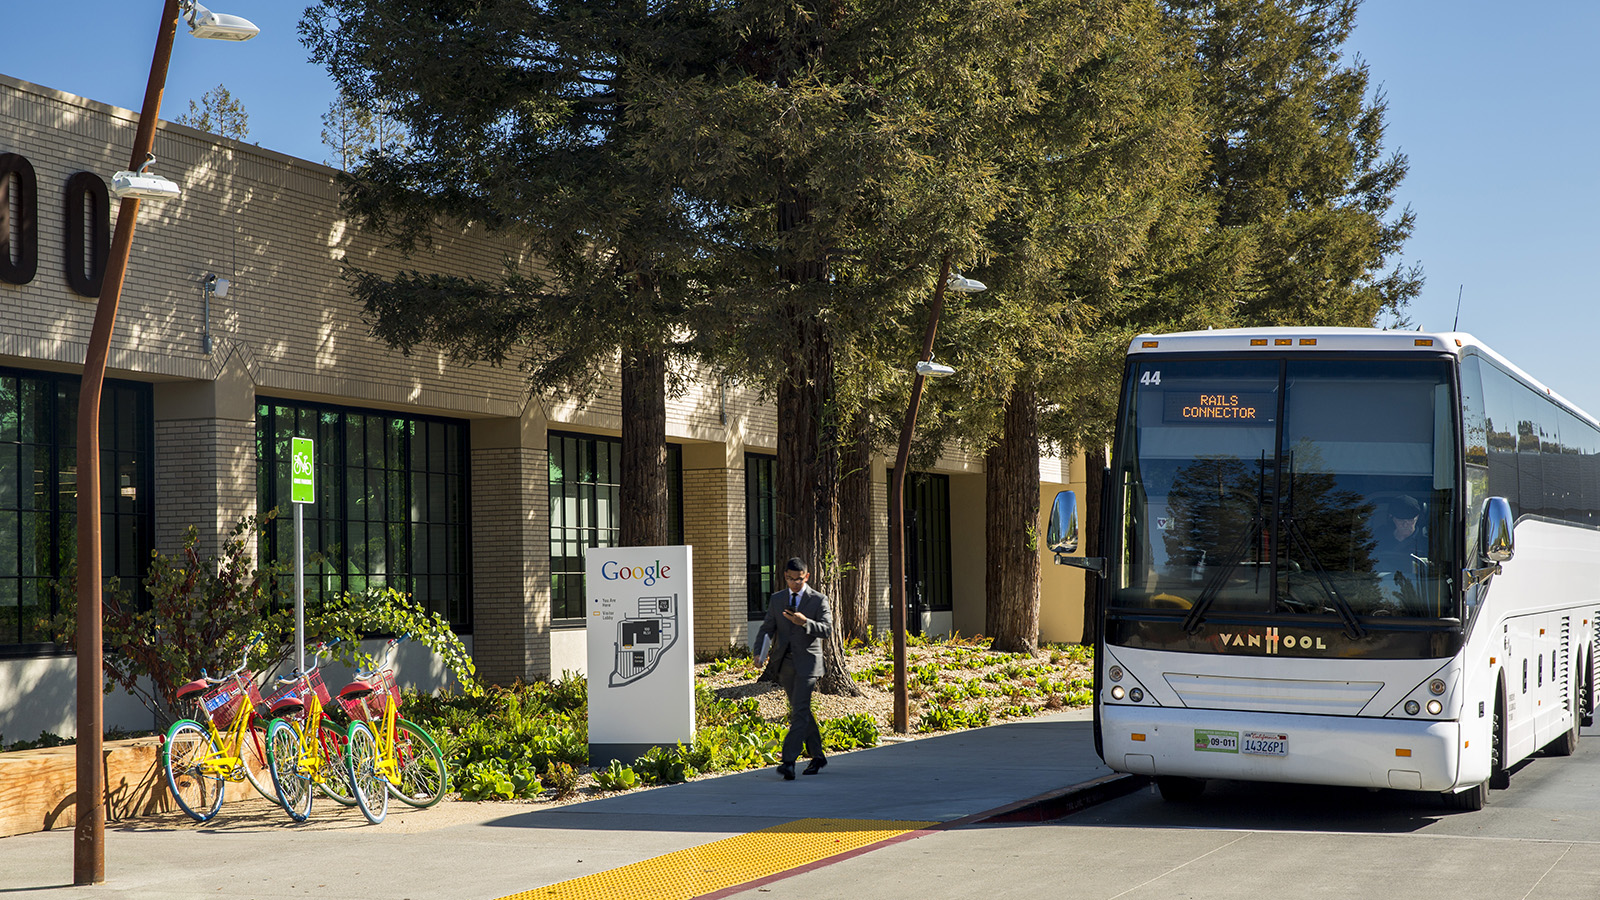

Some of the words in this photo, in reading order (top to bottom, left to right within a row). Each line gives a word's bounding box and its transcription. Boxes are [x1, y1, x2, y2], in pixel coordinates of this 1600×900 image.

[1140, 371, 1161, 385] 44
[1200, 395, 1238, 406] RAILS
[1182, 407, 1256, 418] CONNECTOR
[601, 560, 671, 586] Google
[1245, 740, 1284, 753] 14326P1
